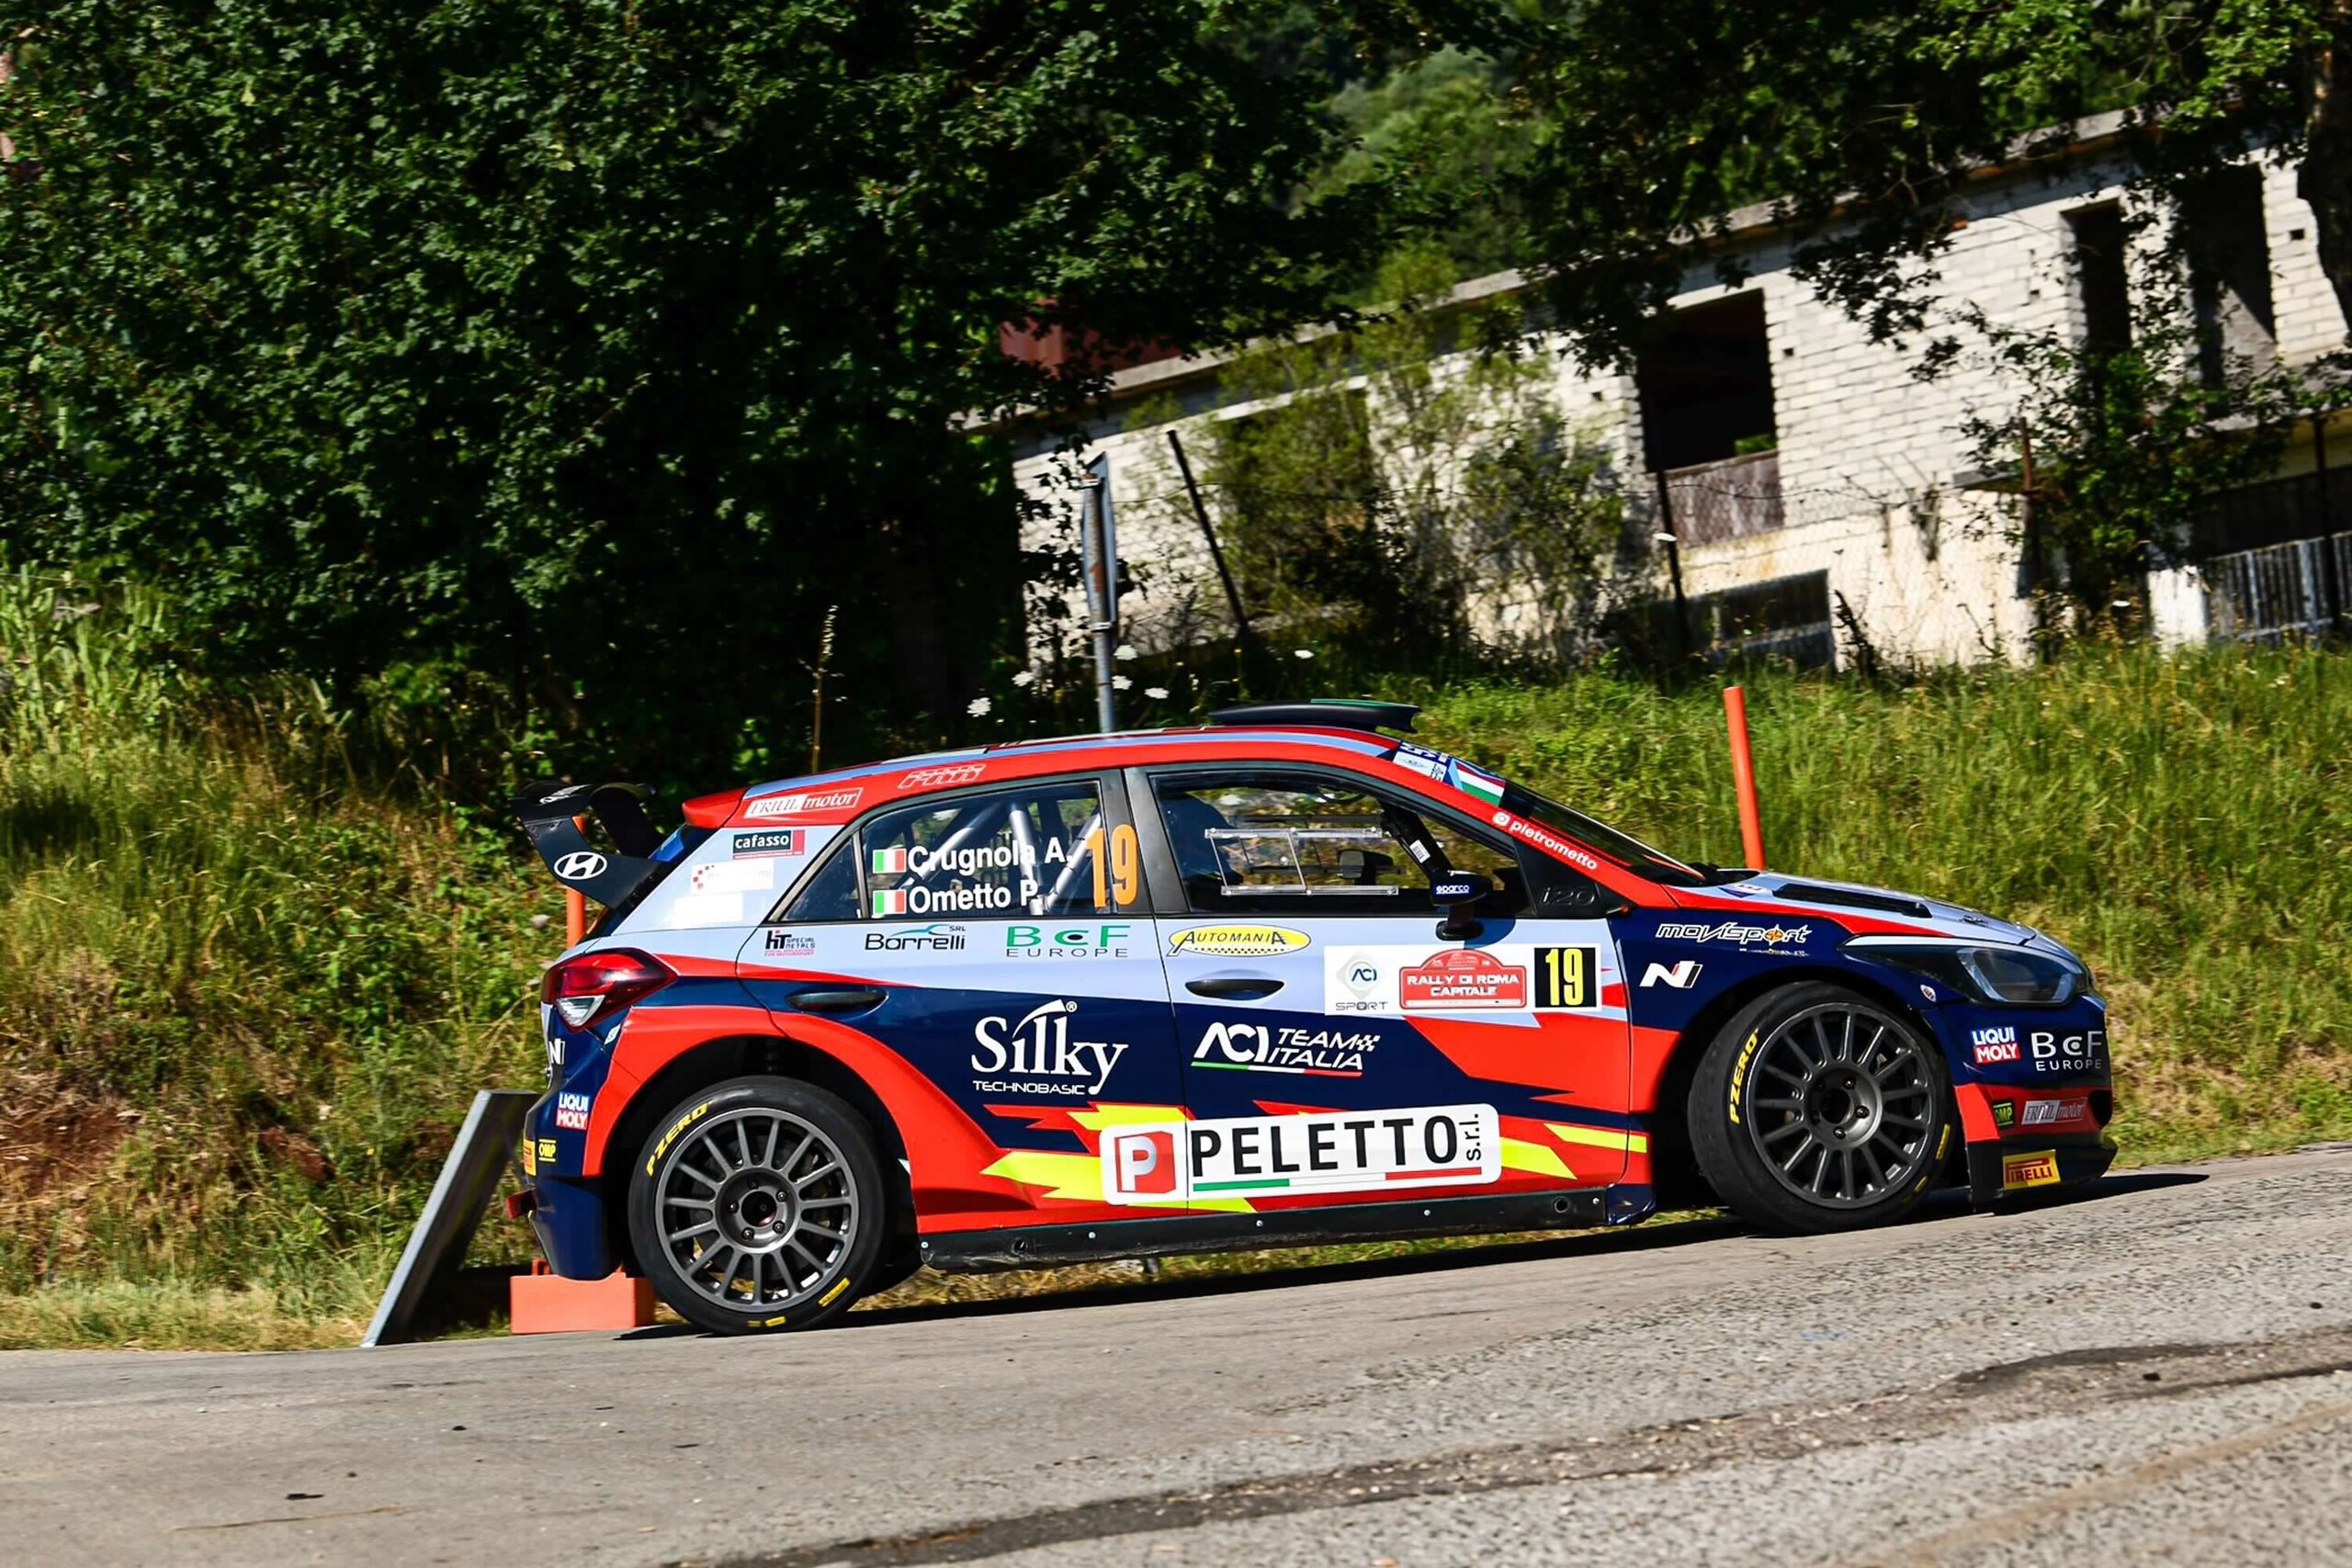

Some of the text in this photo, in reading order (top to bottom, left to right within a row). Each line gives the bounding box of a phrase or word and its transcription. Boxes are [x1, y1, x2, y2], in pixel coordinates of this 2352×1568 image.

[803, 793, 856, 809] motor
[734, 834, 789, 849] cafasso
[1510, 821, 1598, 870] pietrometto
[908, 837, 1074, 875] Crugnola A.
[1086, 824, 1138, 908] 19
[909, 883, 1011, 914] Ometto
[1436, 885, 1470, 895] sparco
[1543, 887, 1596, 906] i20
[1006, 948, 1128, 958] EUROPE
[1351, 967, 1377, 982] ACI
[1407, 974, 1520, 986] RALLY DI ROMA
[1545, 947, 1584, 1007] 19
[1430, 986, 1498, 997] CAPITALE
[1336, 1001, 1388, 1010] SPORT
[1194, 1021, 1358, 1063] ACI TEAM
[1972, 1026, 2015, 1045] LIQUI
[971, 998, 1129, 1096] Silky
[1976, 1043, 2018, 1064] MOLY
[1268, 1046, 1363, 1070] ITALIA
[2035, 1058, 2102, 1072] EUROPE
[973, 1079, 1085, 1095] TECHNOBASIC
[559, 1091, 589, 1111] LIQUI
[557, 1111, 588, 1129] MOLY
[1191, 1114, 1459, 1177] PELETTO
[1460, 1113, 1481, 1162] s.r.l.
[538, 1143, 556, 1158] OMP
[1119, 1135, 1157, 1192] P
[2007, 1157, 2053, 1182] PIRELLI
